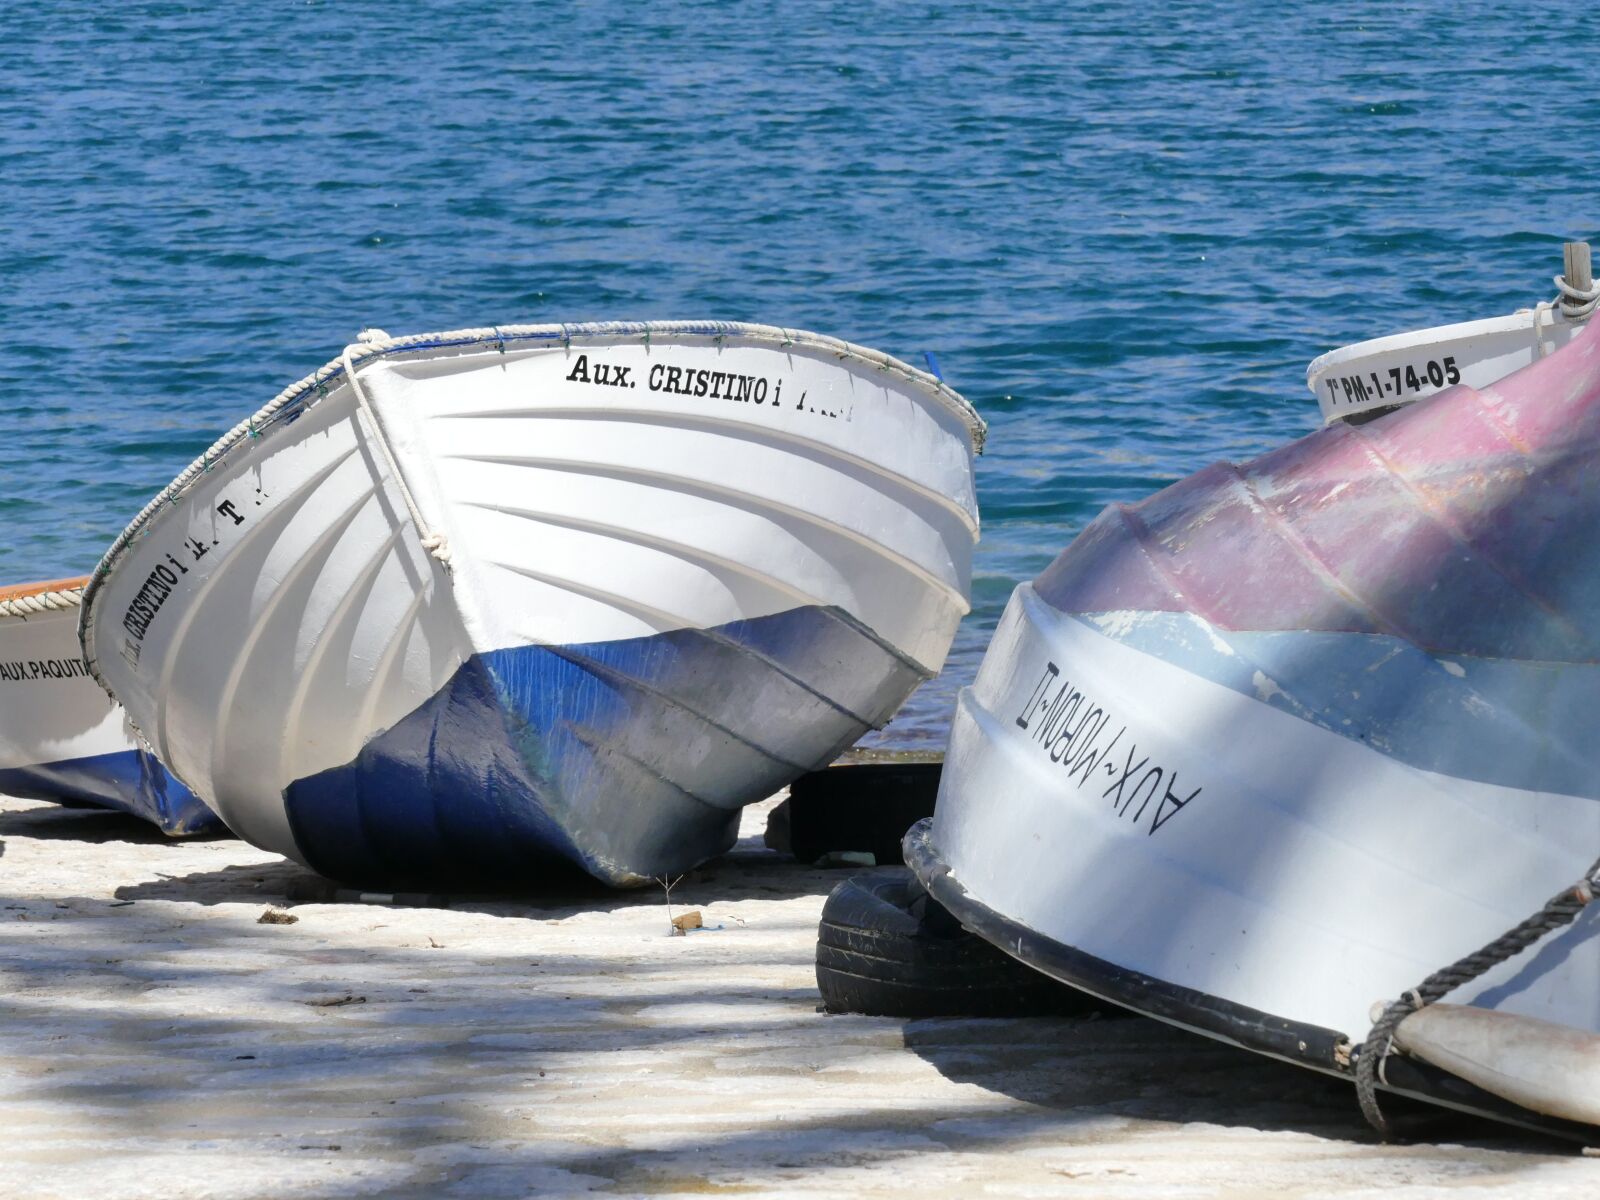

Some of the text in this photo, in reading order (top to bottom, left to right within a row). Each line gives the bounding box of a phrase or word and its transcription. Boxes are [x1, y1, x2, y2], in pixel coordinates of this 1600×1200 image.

[566, 355, 636, 388] Aux.
[649, 363, 767, 405] CRISTINO
[1340, 356, 1461, 403] PM-1-74-05
[122, 563, 178, 641] CRISTINO
